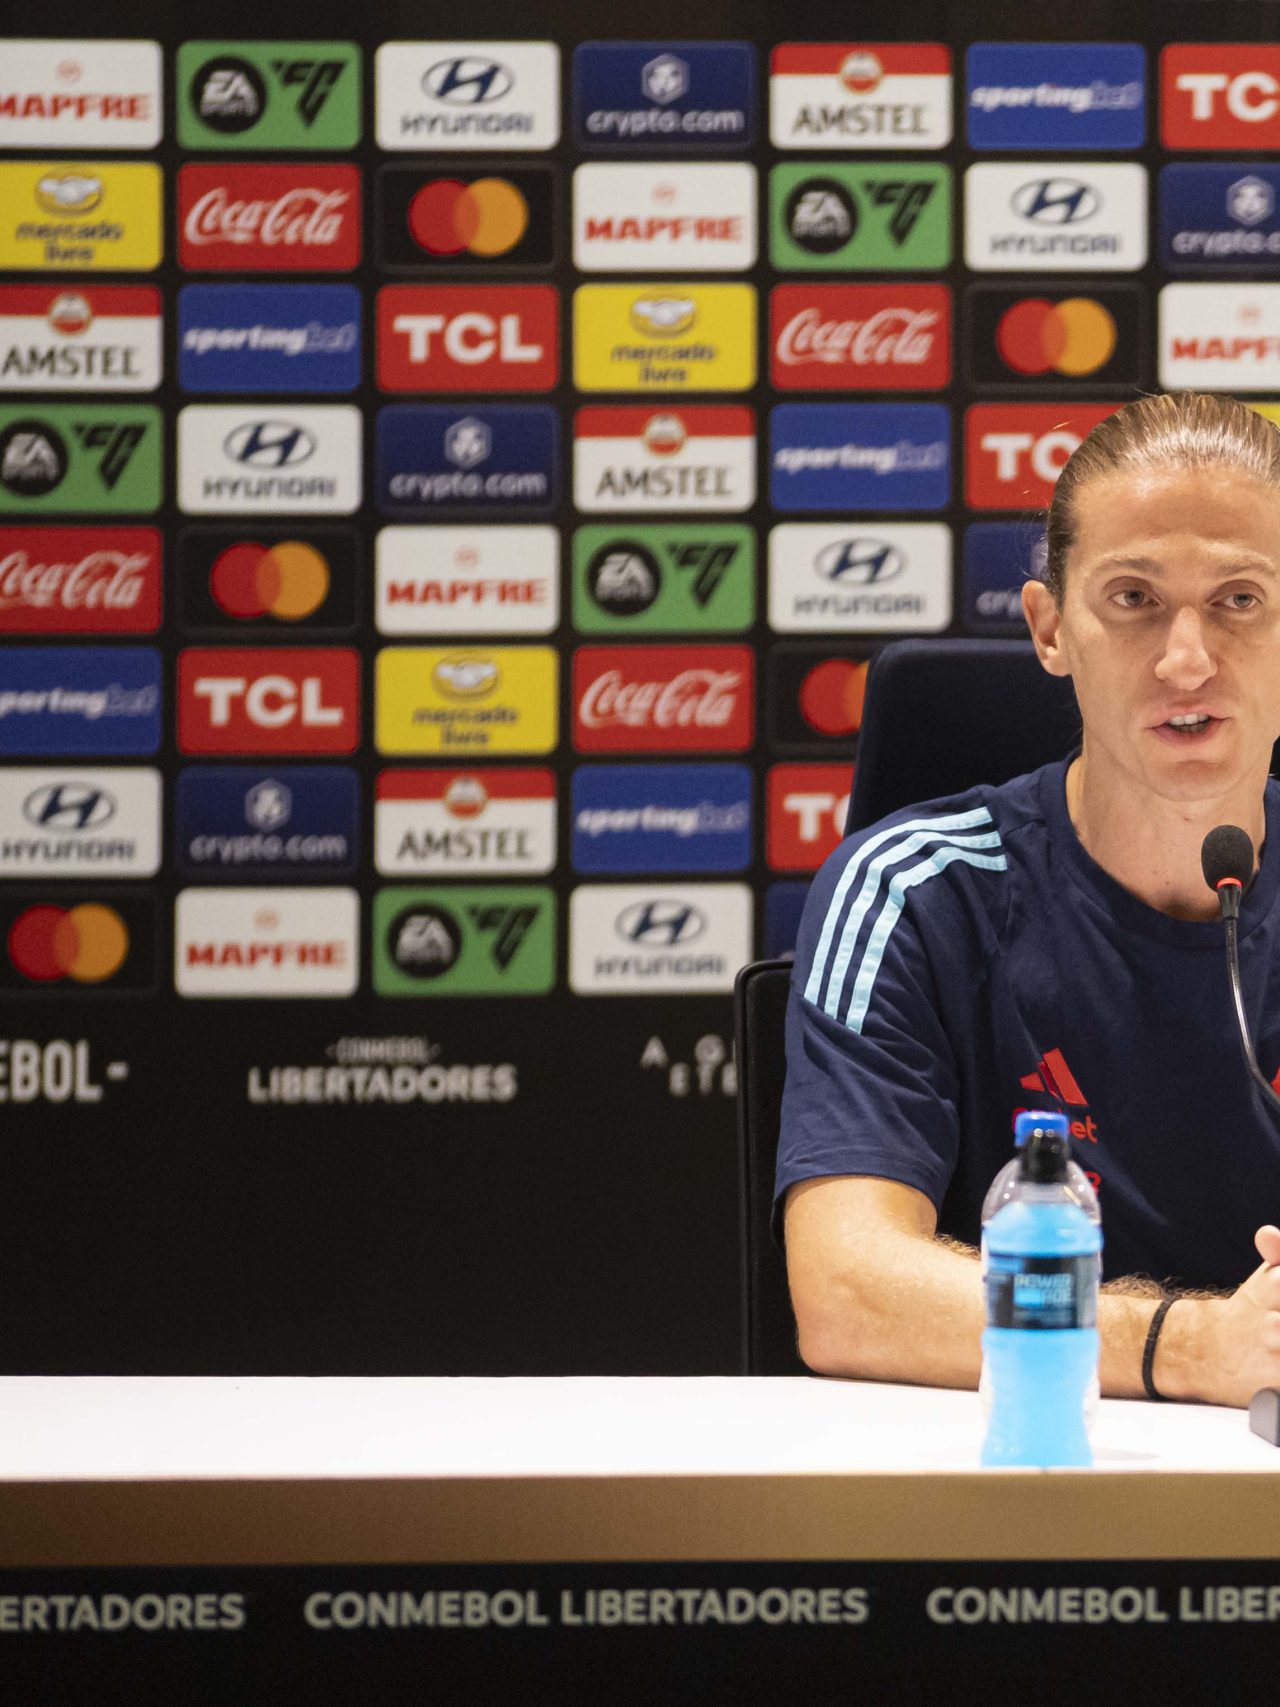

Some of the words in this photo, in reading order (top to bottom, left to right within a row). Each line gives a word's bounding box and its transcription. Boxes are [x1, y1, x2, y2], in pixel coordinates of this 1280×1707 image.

[401, 113, 533, 135] HYUNDAI
[587, 109, 743, 134] crypto.com
[792, 104, 926, 134] AMSTEL
[584, 215, 741, 242] MAPFRE
[990, 234, 1121, 255] HYUNDAI
[394, 313, 542, 363] TCL
[1, 347, 139, 377] AMSTEL
[981, 431, 1078, 483] TC
[203, 477, 336, 499] HYUNDAI
[390, 472, 546, 498] crypto.com
[596, 467, 729, 497] AMSTEL
[387, 578, 544, 605] MAPFRE
[794, 594, 925, 615] HYUNDAI
[195, 676, 343, 727] TCL
[2, 840, 135, 861] HYUNDAI
[190, 835, 346, 860] crypto.com
[397, 830, 528, 859] AMSTEL
[187, 941, 343, 967] MAPFRE
[594, 955, 726, 978] HYUNDAI
[248, 1065, 518, 1102] LIBERTADORES
[0, 1594, 244, 1629] ERTADORES
[305, 1590, 548, 1628] CONMEBOL
[562, 1588, 868, 1625] LIBERTADORES
[927, 1587, 1167, 1623] CONMEBOL
